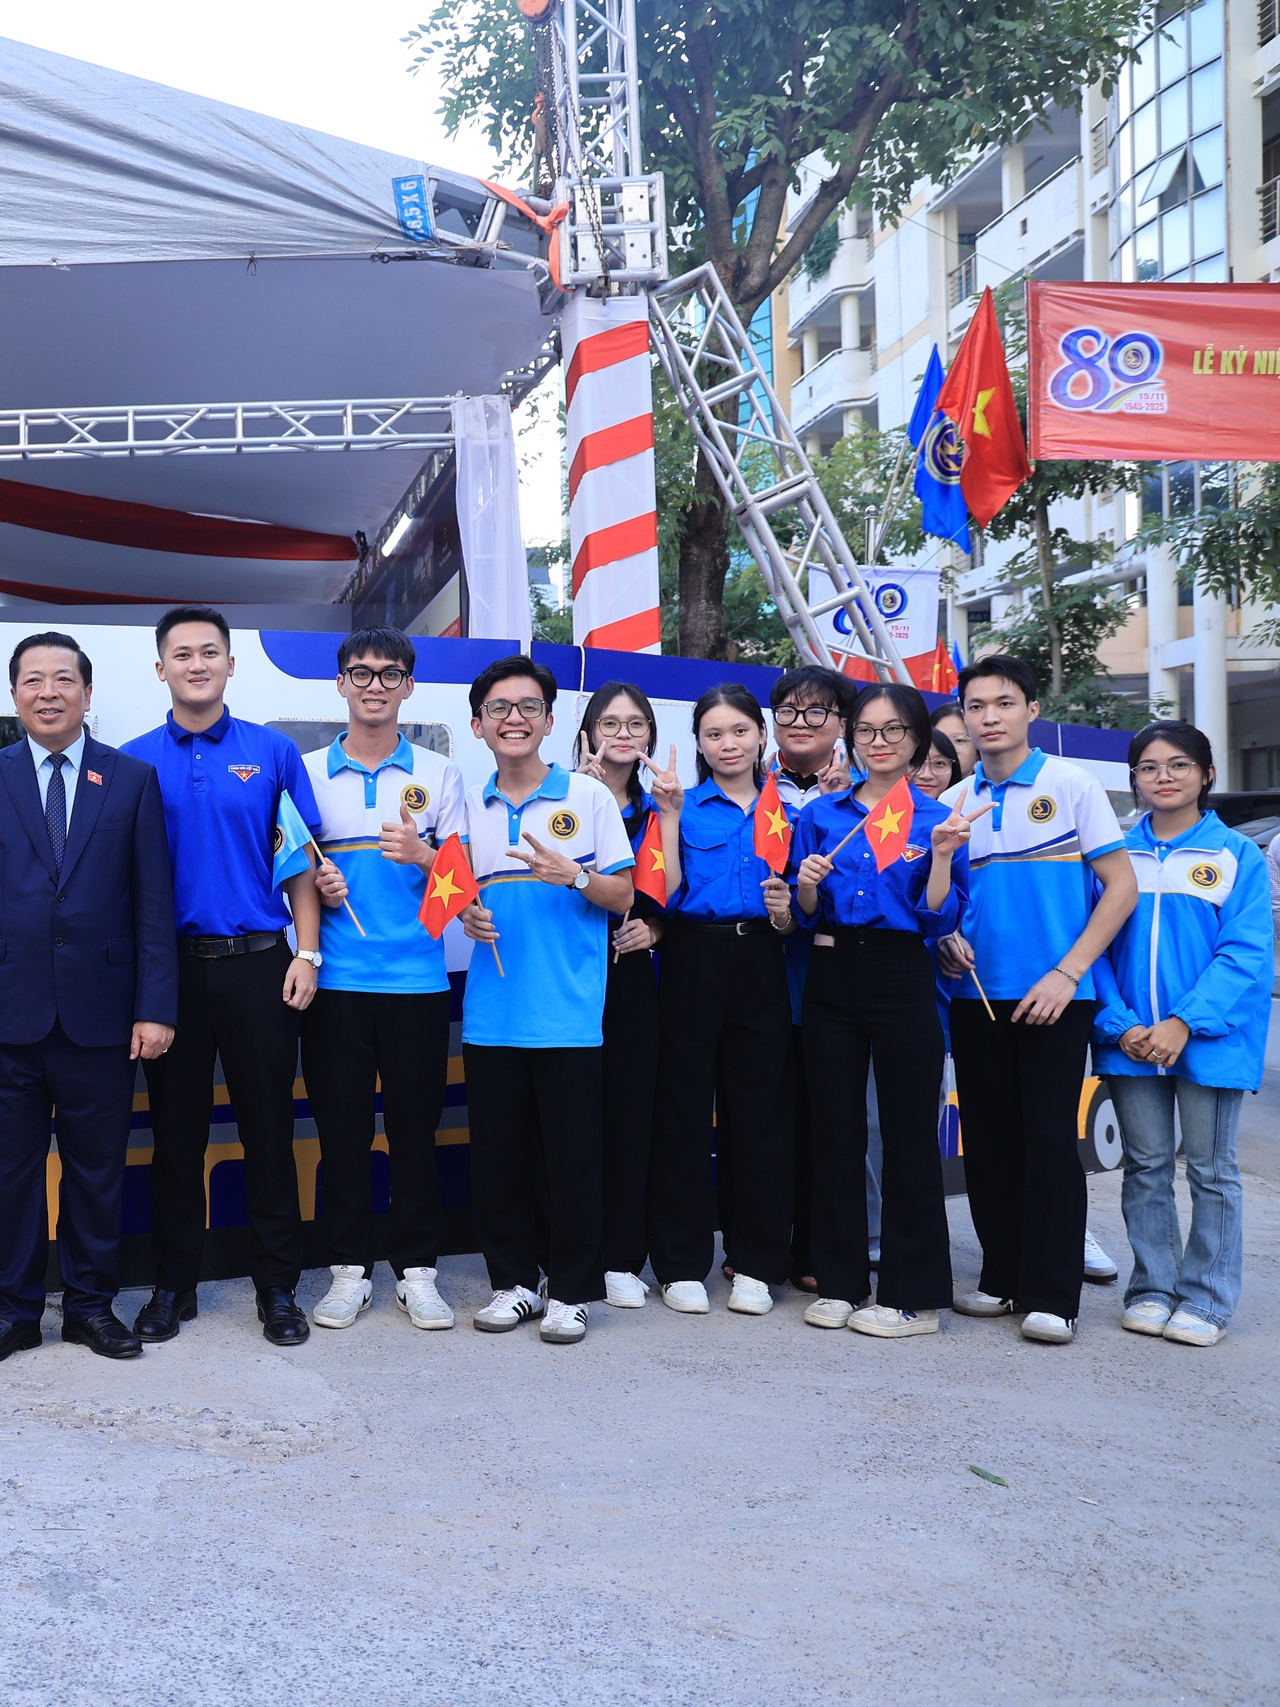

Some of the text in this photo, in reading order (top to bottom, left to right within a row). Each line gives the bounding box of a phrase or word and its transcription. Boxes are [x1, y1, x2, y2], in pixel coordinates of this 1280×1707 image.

[1051, 328, 1160, 409] 80
[1192, 343, 1215, 375] LỄ
[1219, 344, 1249, 375] KỶ
[1124, 402, 1165, 411] 1945-2025
